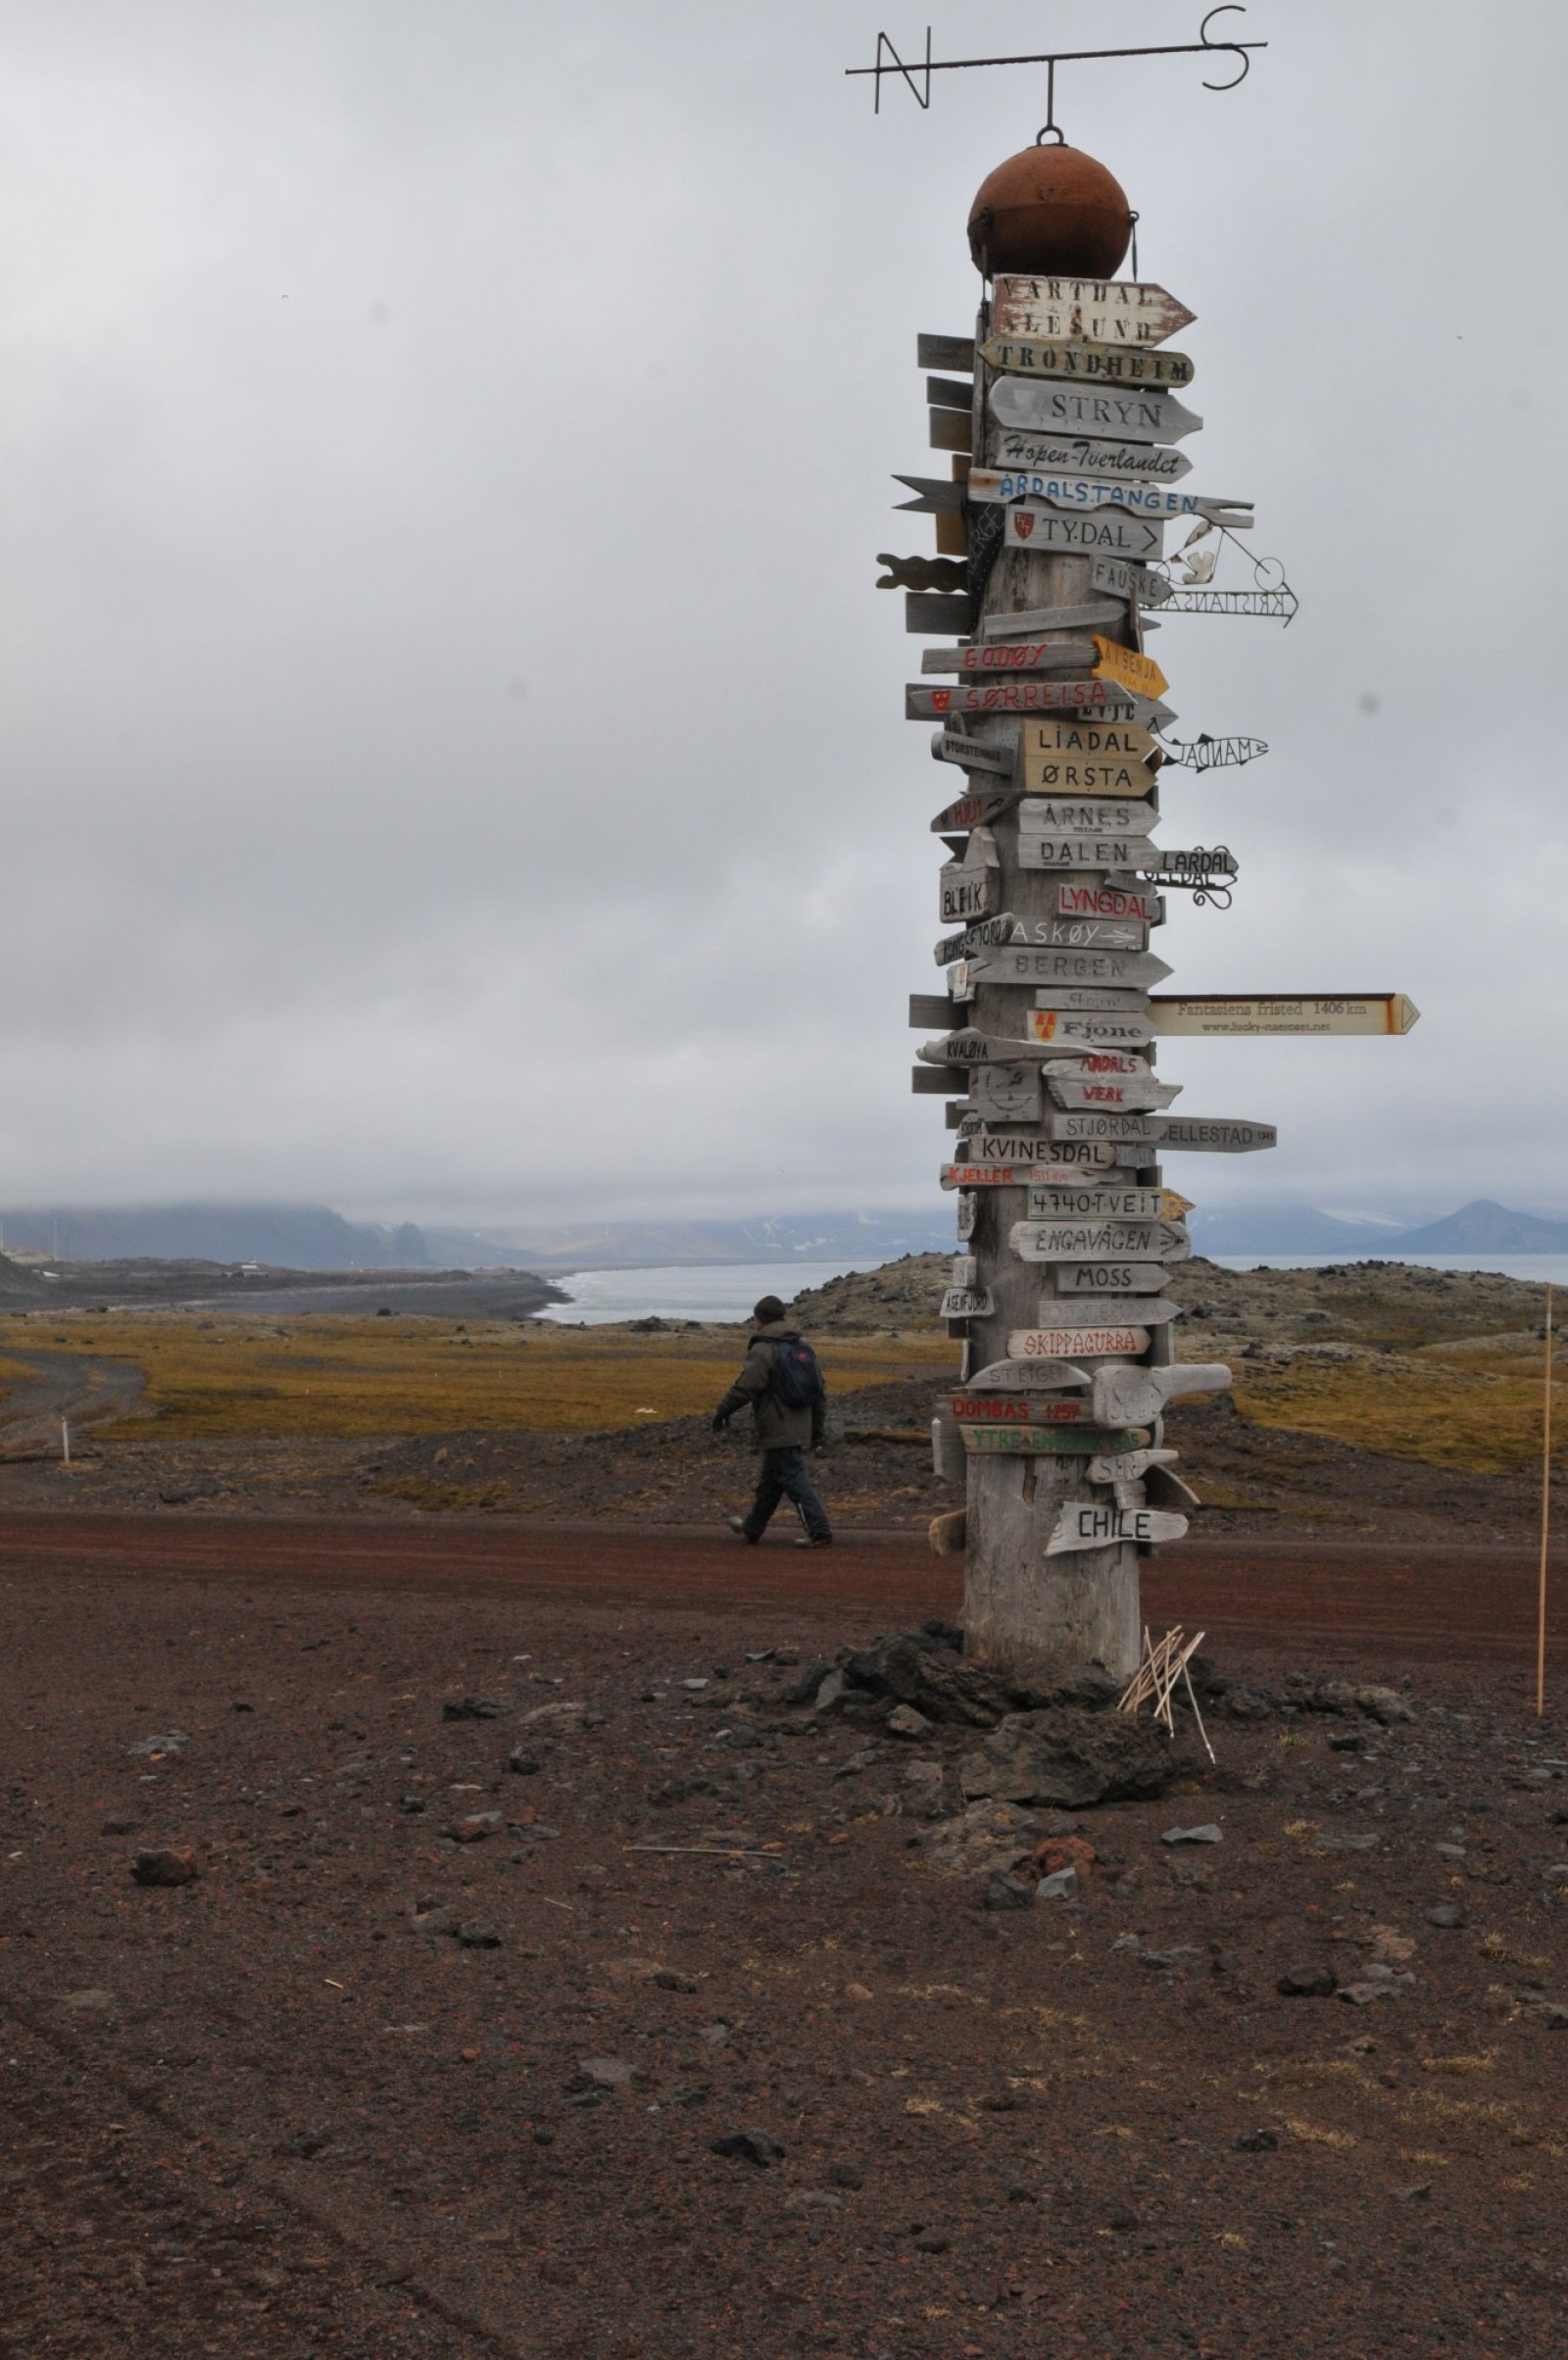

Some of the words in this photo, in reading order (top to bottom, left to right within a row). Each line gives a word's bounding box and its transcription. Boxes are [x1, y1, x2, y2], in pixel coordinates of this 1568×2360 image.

[874, 25, 932, 114] N
[1200, 5, 1250, 91] S
[998, 346, 1189, 381] TRONDHEIM
[1052, 394, 1162, 428] STRYN
[1000, 473, 1200, 513] ÅRDALSTANGEN
[1042, 517, 1131, 549] TYDAL
[1095, 567, 1158, 598] FAUSKE
[965, 681, 1108, 710] SØRREISA
[1040, 726, 1139, 754] LIADAL
[1042, 764, 1133, 788] ØRSTA
[1041, 842, 1129, 862] DALEN
[1060, 886, 1153, 920] LYNGDAL
[1011, 921, 1100, 946] ASKØY
[1014, 954, 1126, 979] BERGEN
[1176, 1002, 1251, 1016] Fantasiens
[1256, 1002, 1303, 1016] fristed
[1062, 1018, 1142, 1039] Fjone
[947, 1039, 989, 1059] KVALØYA
[1065, 1117, 1152, 1136] STJØRDAL
[982, 1138, 1106, 1164] KVINESDAL
[1035, 1224, 1152, 1252] ENGAVÅGEN
[1076, 1266, 1132, 1288] MOSS
[952, 1397, 1029, 1419] DOMBÅS
[972, 1429, 1020, 1450] YTRE
[1079, 1510, 1152, 1540] CHILE
